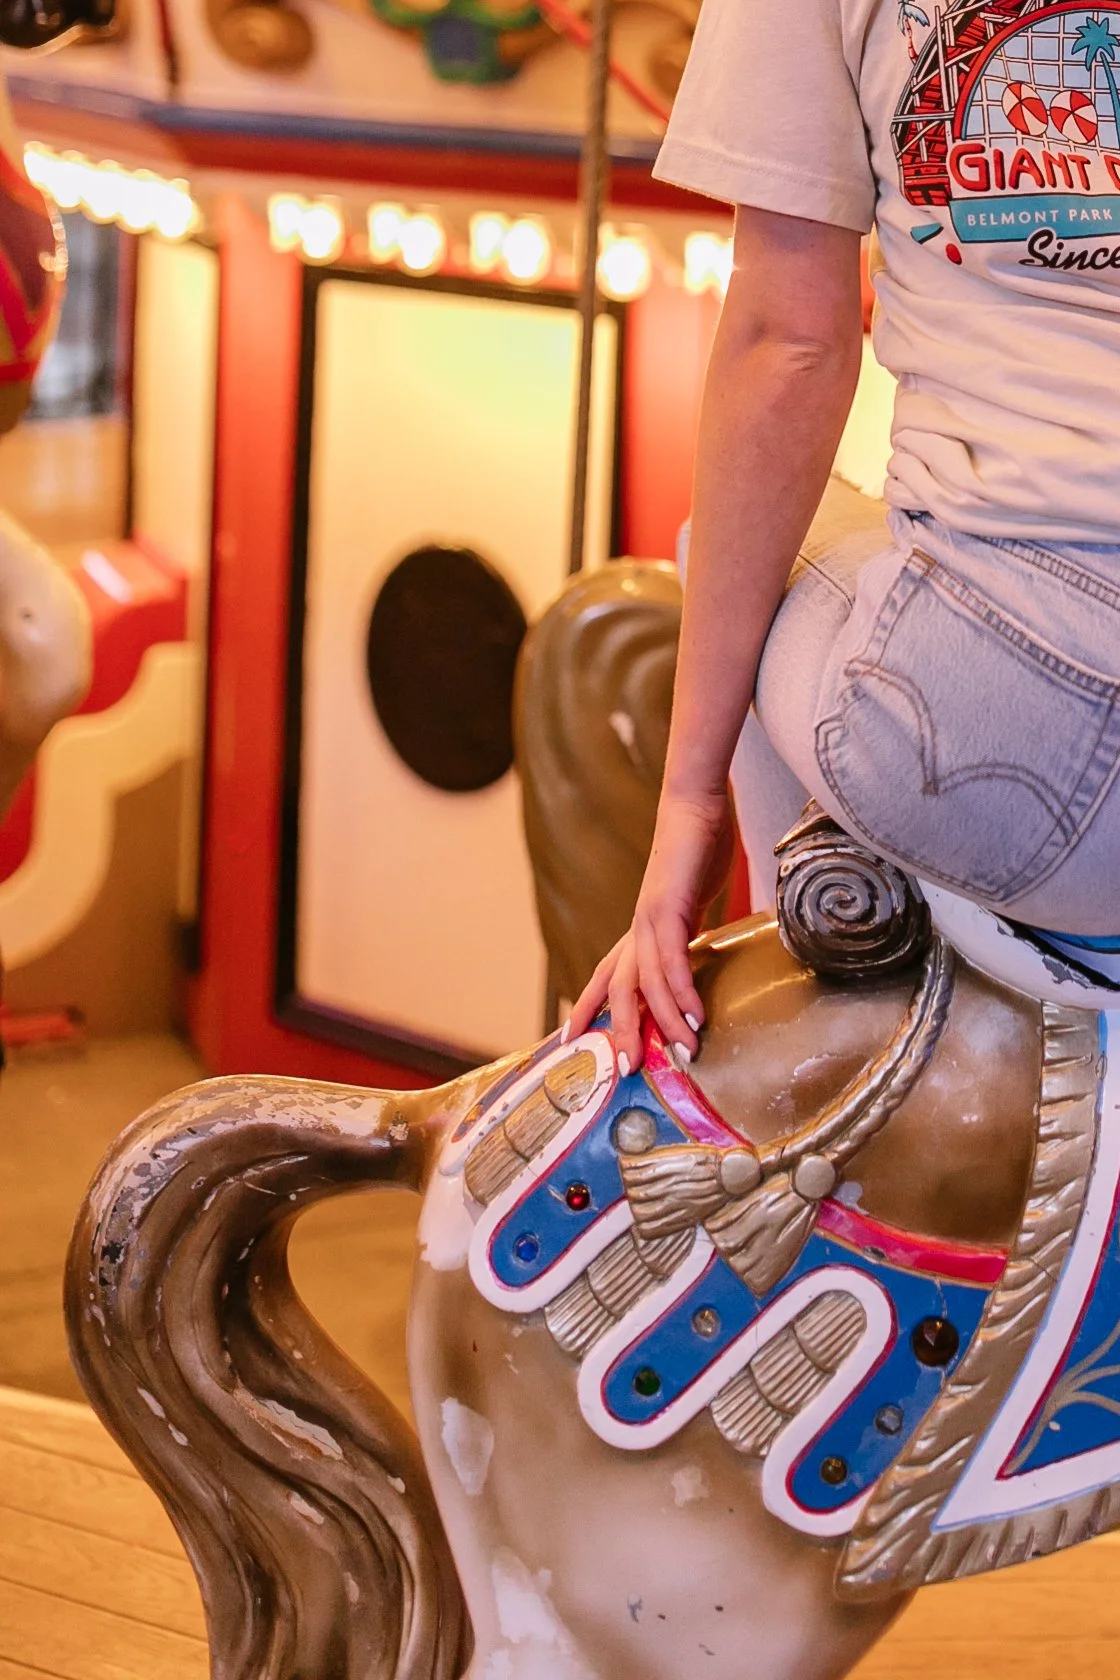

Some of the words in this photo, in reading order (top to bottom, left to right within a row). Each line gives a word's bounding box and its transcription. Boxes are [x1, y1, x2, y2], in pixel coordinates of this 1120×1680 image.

[950, 143, 1091, 192] GIANT
[967, 210, 1059, 226] BELMONT
[1069, 208, 1113, 221] PARK
